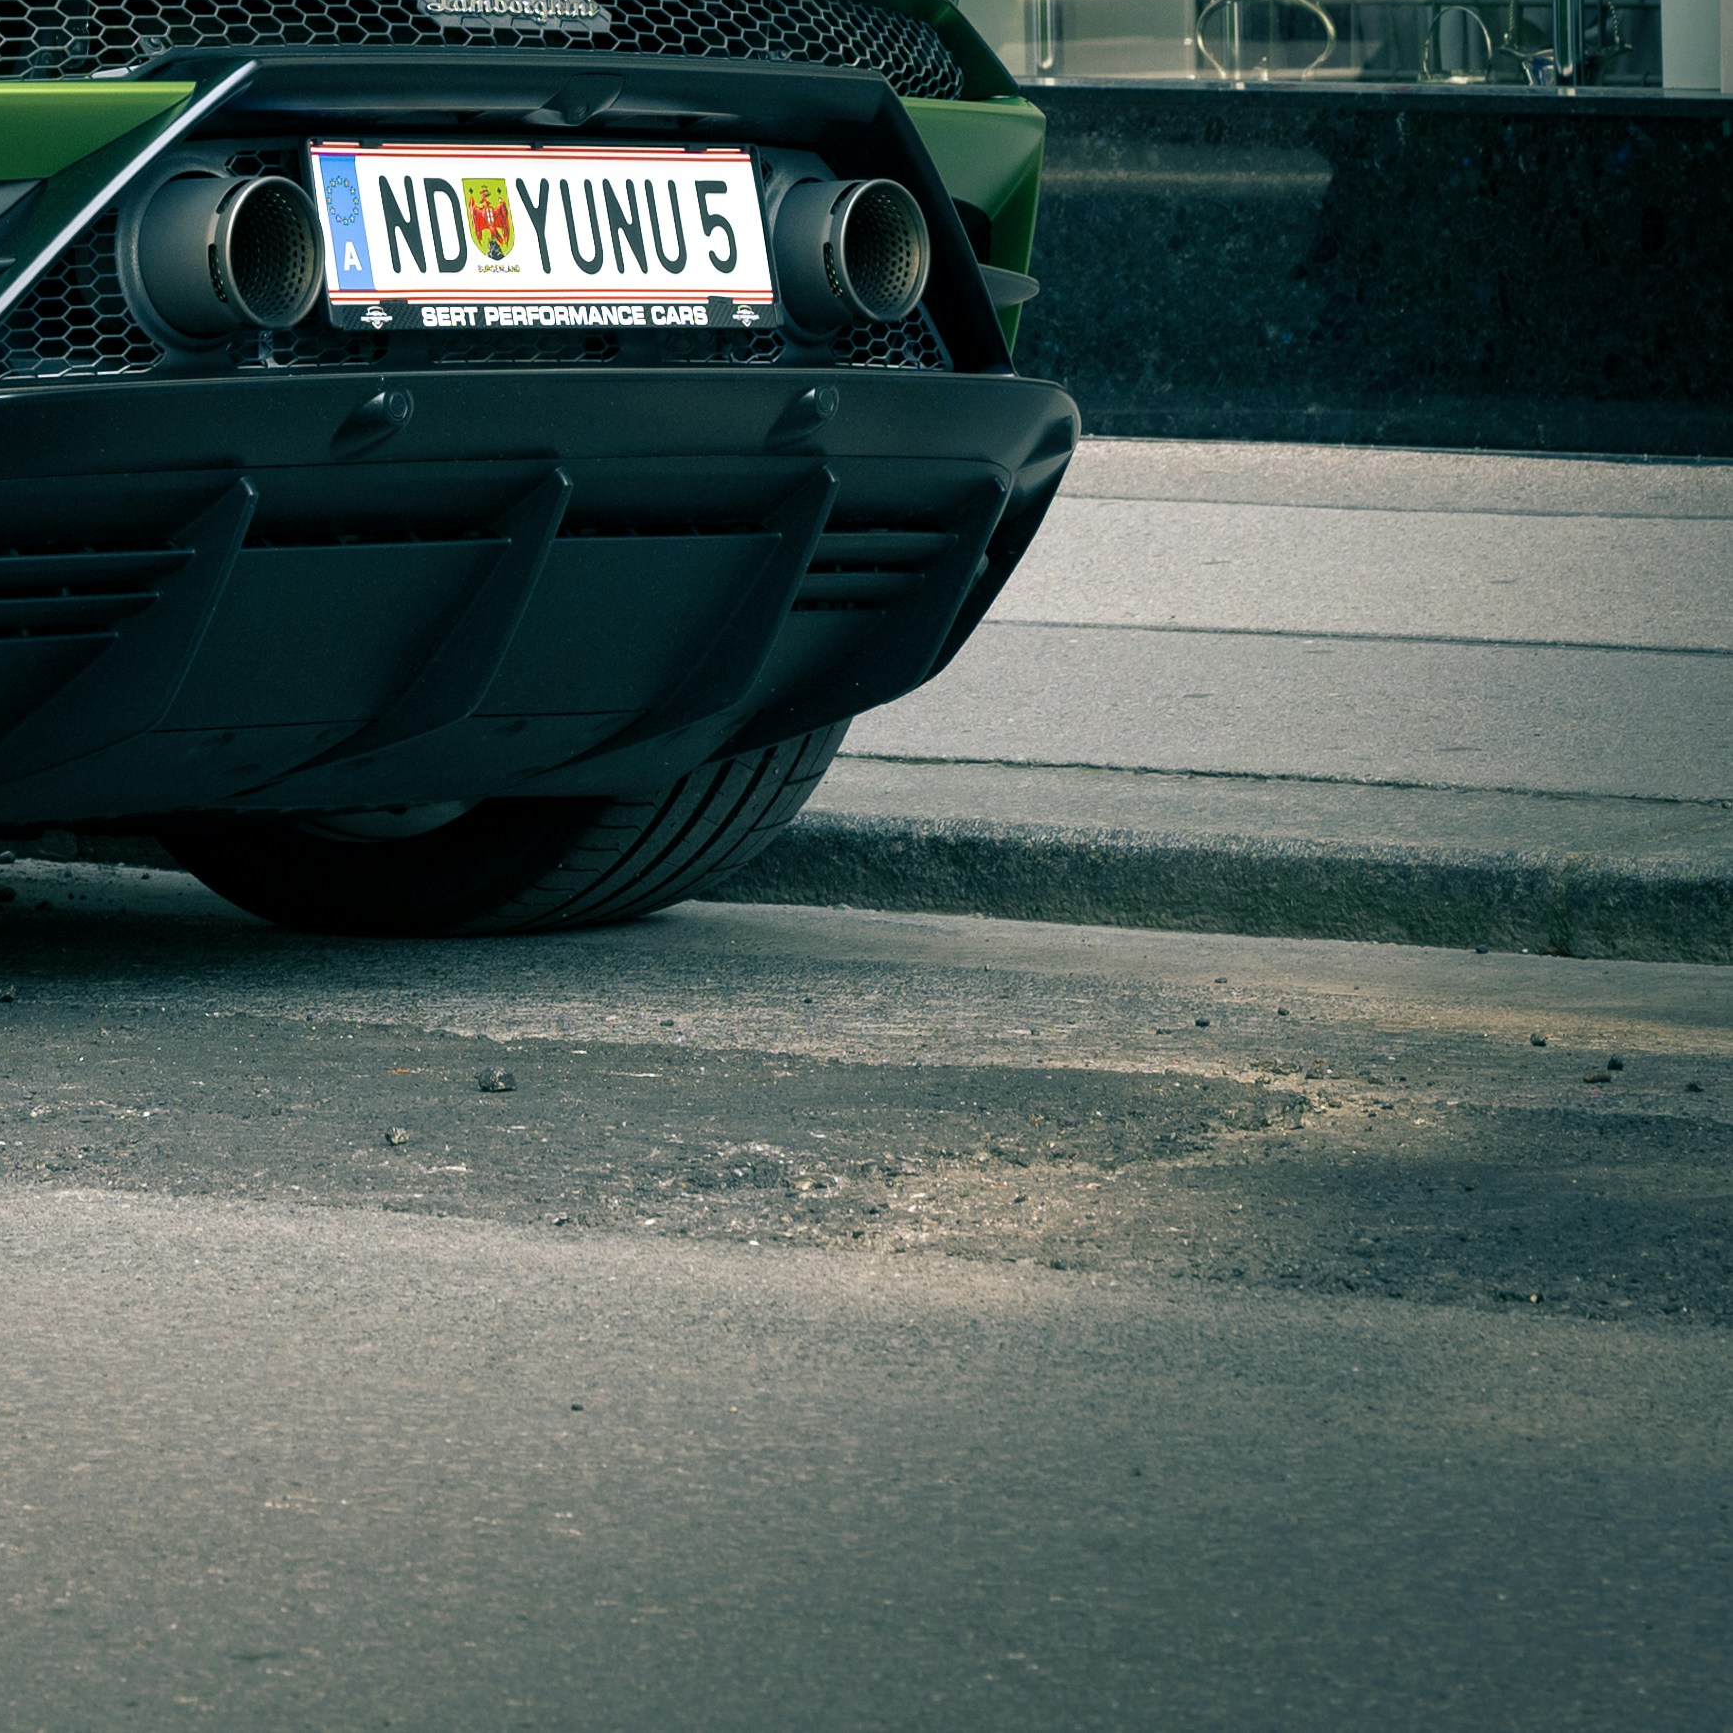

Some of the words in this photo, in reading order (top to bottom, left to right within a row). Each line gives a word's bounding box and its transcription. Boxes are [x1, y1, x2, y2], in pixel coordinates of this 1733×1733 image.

[378, 175, 468, 275] ND
[343, 239, 363, 272] A
[421, 305, 478, 327] SERT
[483, 305, 647, 327] PERFORMANCE
[650, 305, 708, 326] CARS
